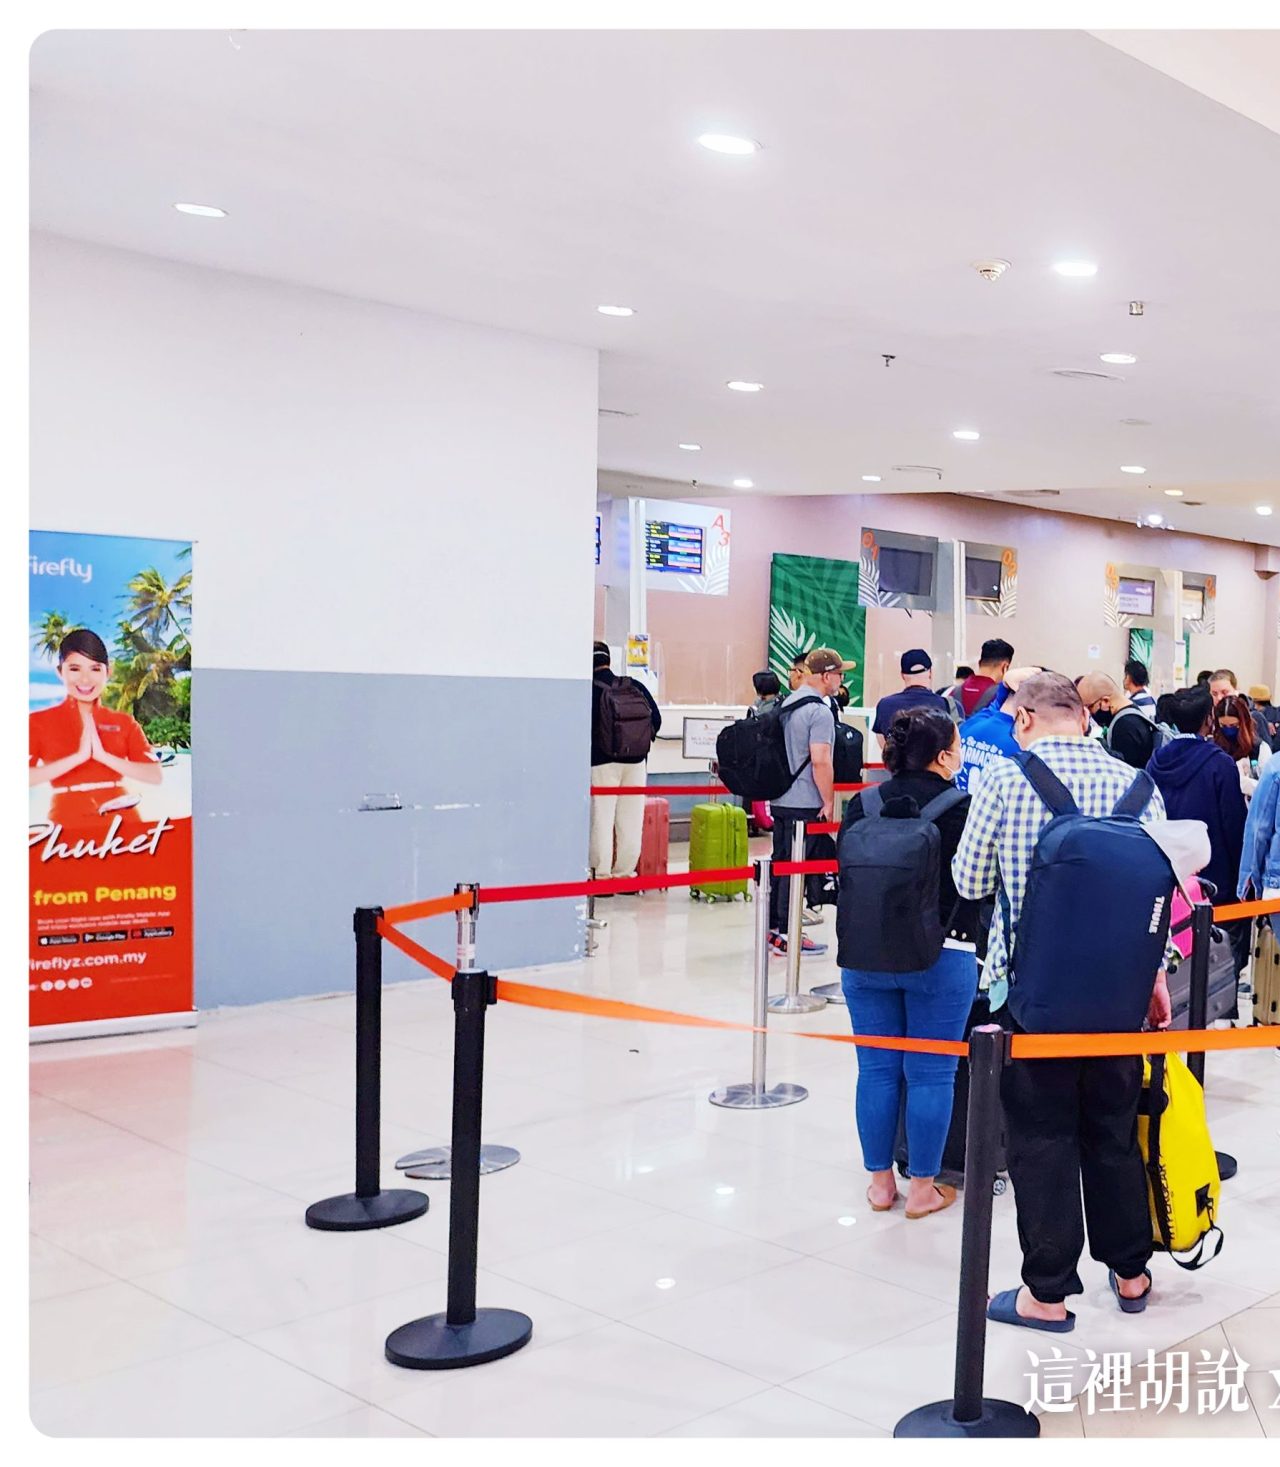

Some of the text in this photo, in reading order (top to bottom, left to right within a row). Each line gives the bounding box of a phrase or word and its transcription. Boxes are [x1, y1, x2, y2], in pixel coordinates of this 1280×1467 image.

[29, 555, 93, 583] irefly
[33, 885, 177, 906] from Penang
[1148, 895, 1166, 934] THULE
[29, 952, 147, 971] ireflyz.com.my
